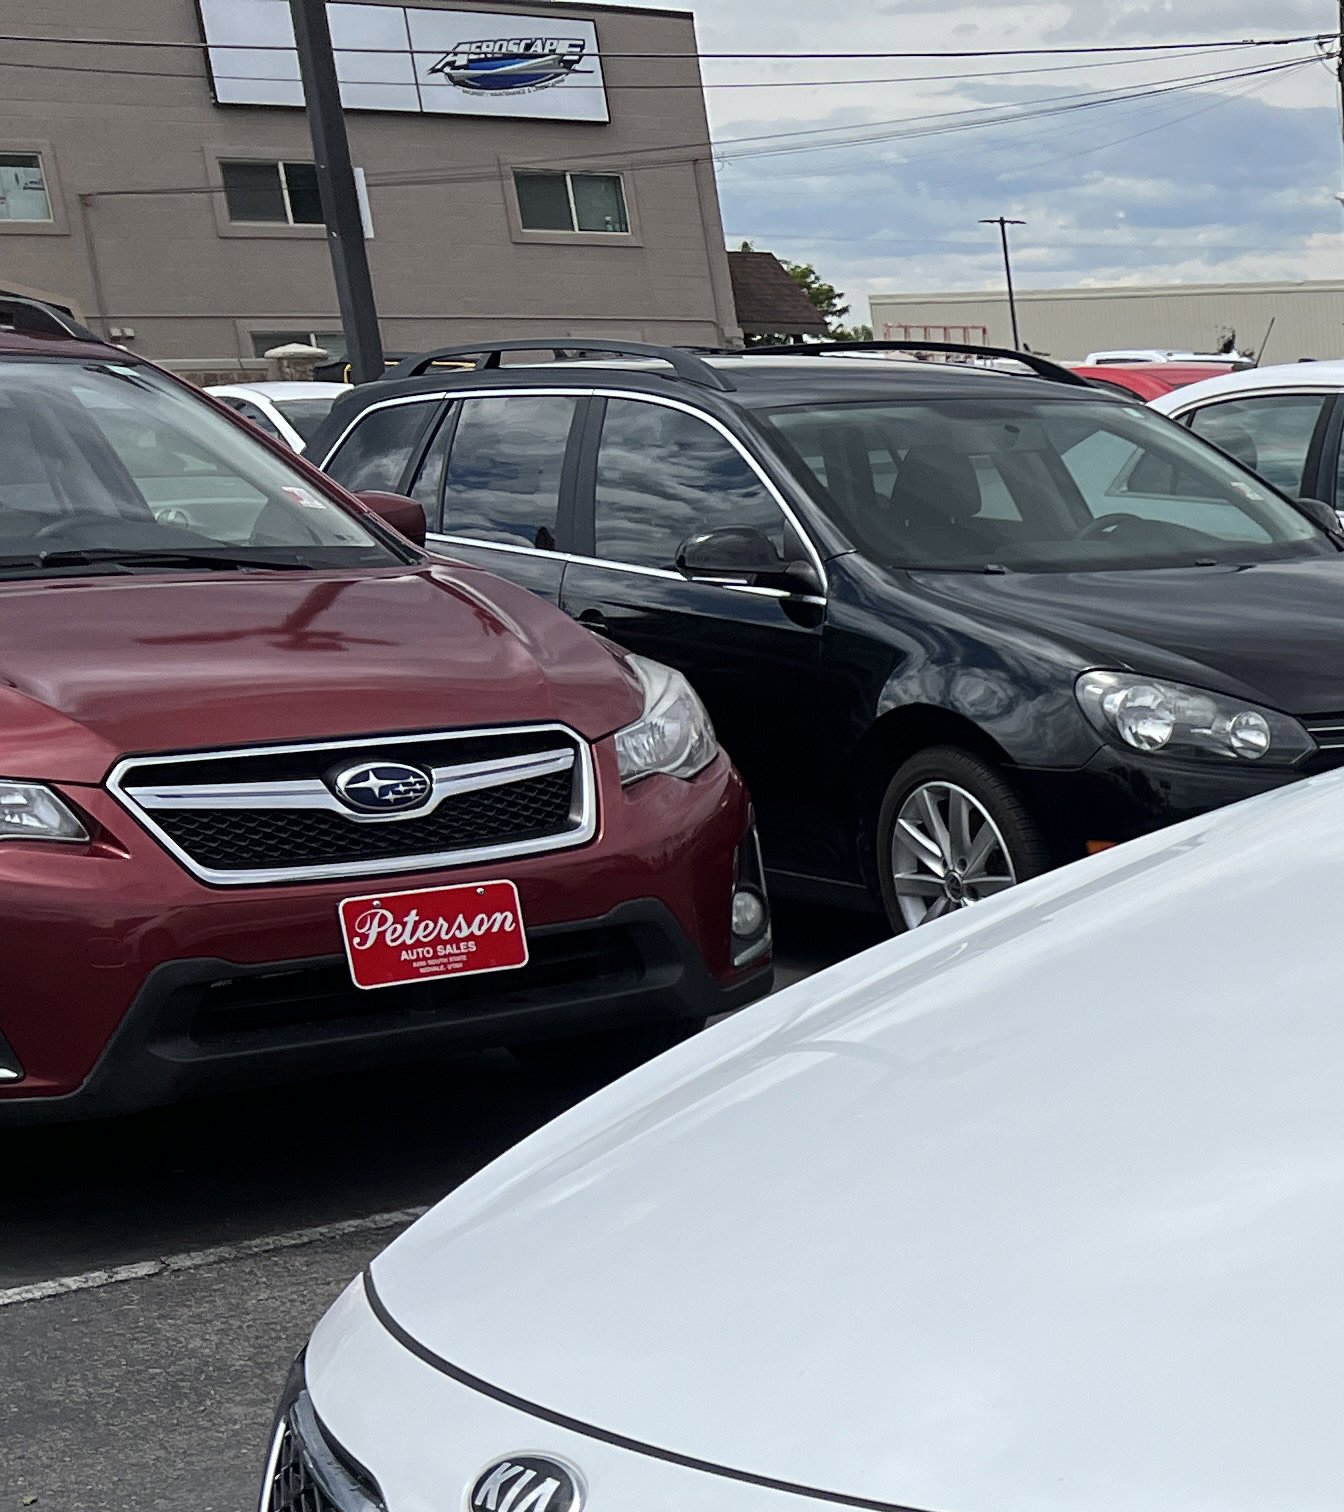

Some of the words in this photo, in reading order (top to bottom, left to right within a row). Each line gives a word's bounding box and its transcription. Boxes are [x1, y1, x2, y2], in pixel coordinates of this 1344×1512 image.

[433, 38, 584, 70] AEROSCAPE
[353, 908, 516, 950] Peterson
[401, 947, 433, 961] AUTO
[437, 941, 477, 956] SALES
